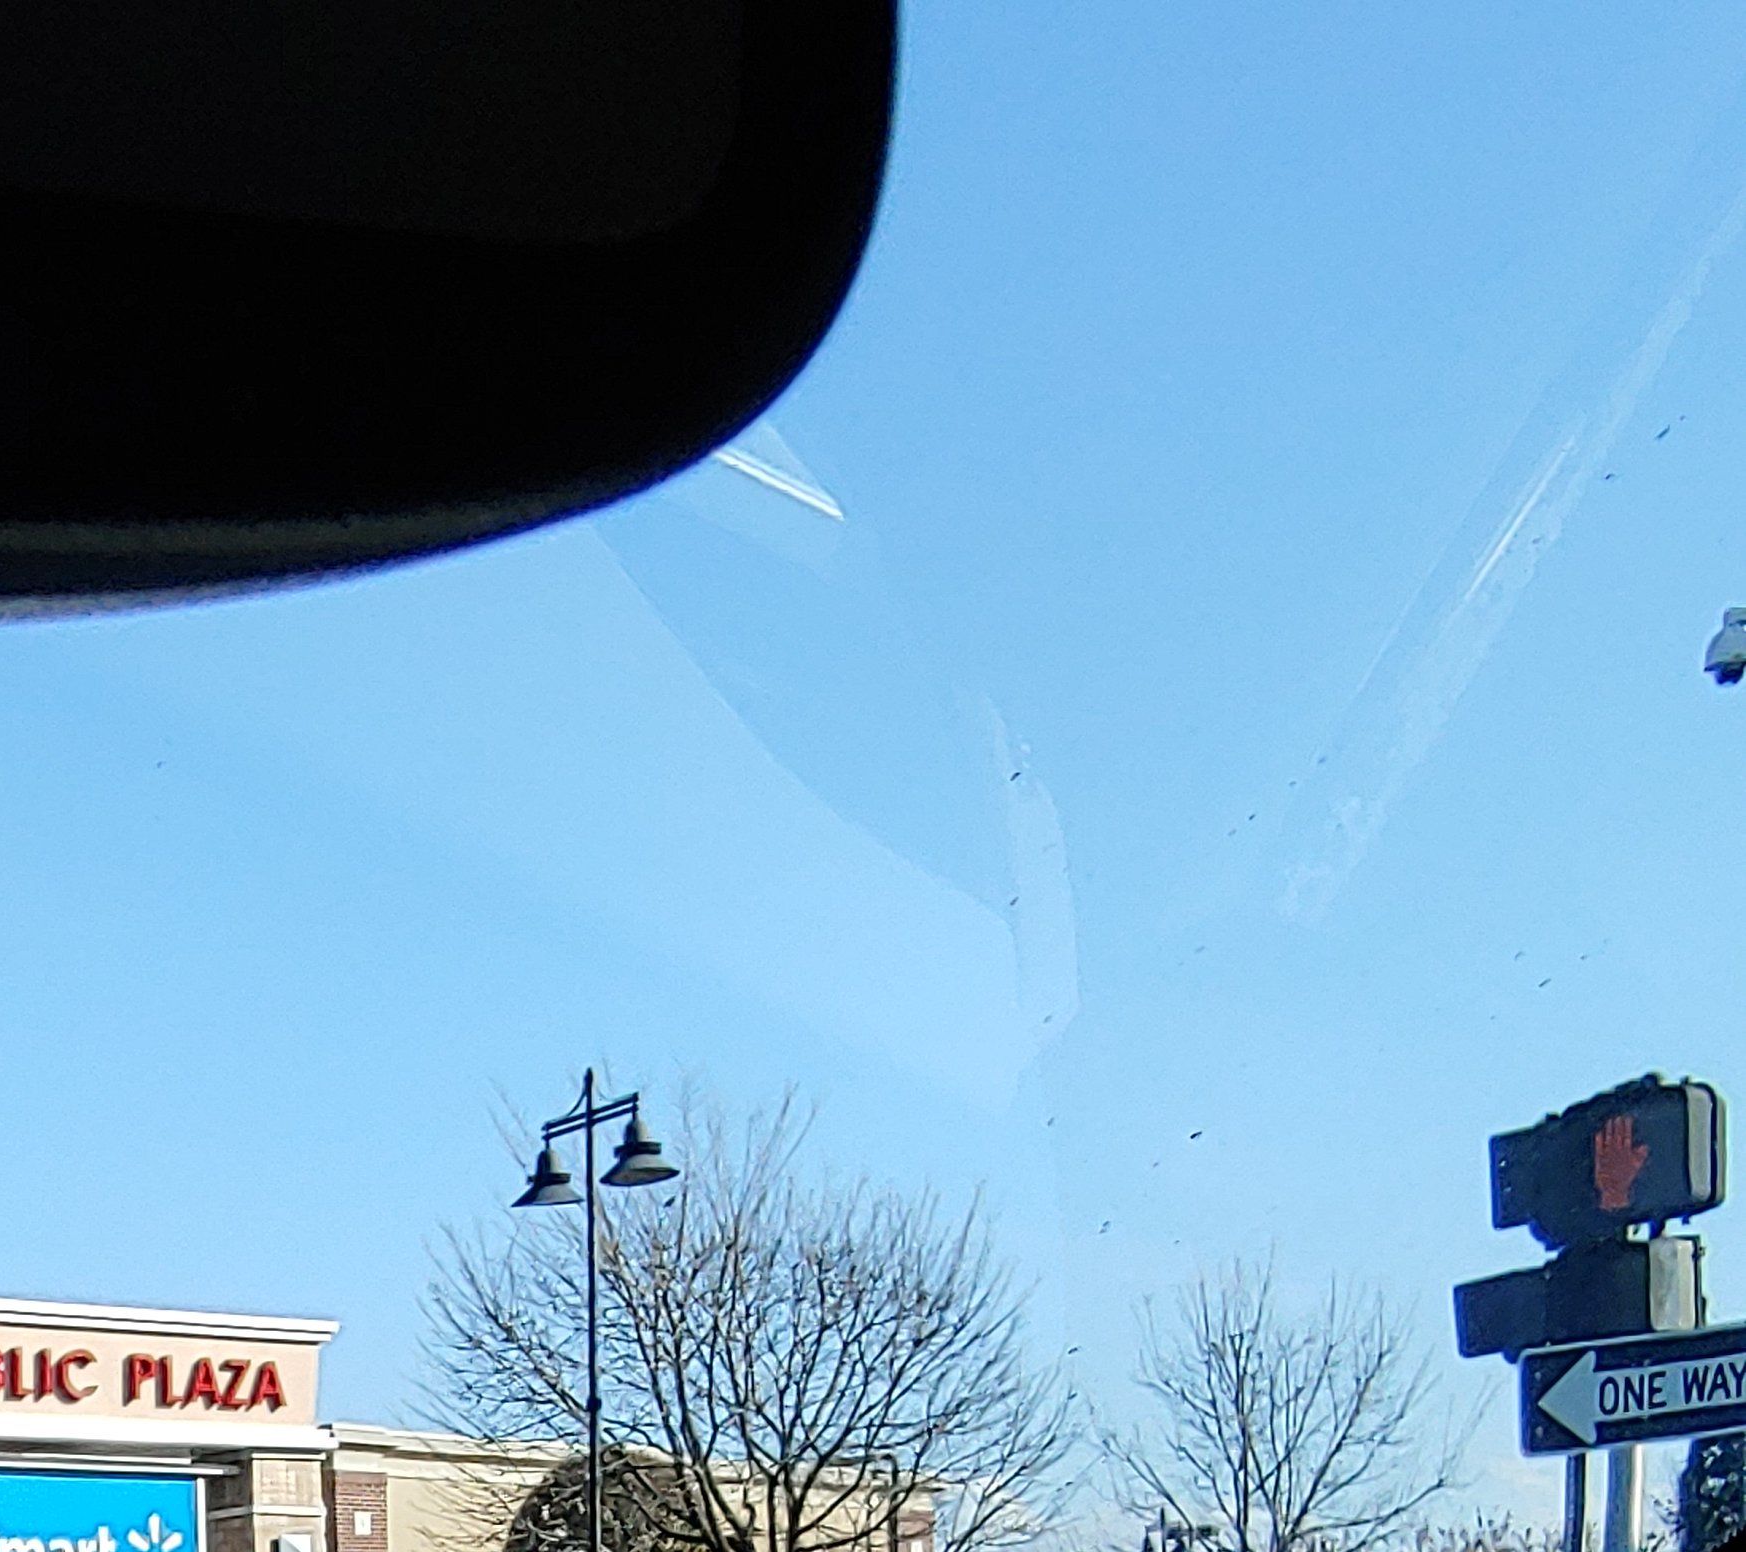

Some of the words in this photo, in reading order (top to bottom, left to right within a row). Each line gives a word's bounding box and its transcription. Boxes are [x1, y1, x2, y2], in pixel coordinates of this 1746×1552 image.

[123, 1351, 288, 1412] PLAZA
[1598, 1370, 1668, 1416] ONE
[1681, 1361, 1746, 1405] WAY
